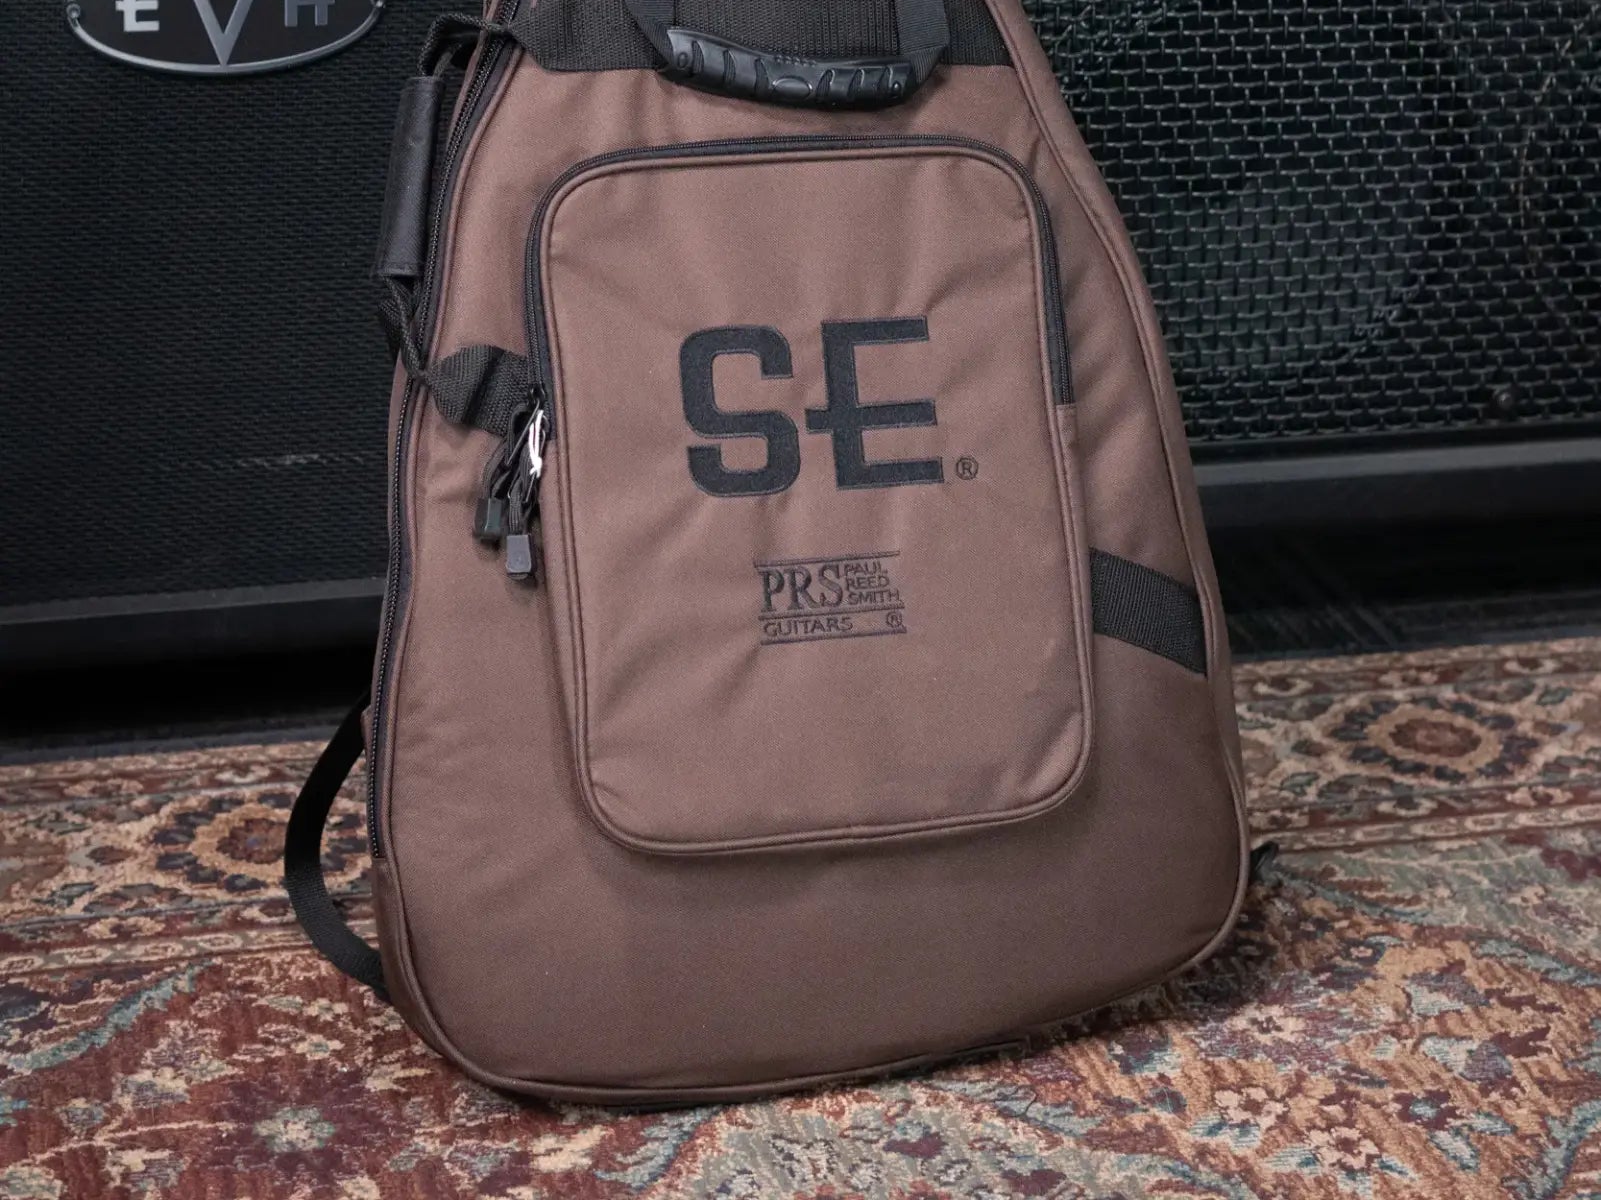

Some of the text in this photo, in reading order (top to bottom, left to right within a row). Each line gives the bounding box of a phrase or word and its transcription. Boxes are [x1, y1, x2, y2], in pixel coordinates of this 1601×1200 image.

[680, 315, 944, 497] SE
[843, 560, 888, 577] PAUL
[757, 563, 844, 613] PRS
[846, 575, 890, 591] REED
[848, 589, 900, 606] SMITH
[763, 616, 853, 638] GUITARS
